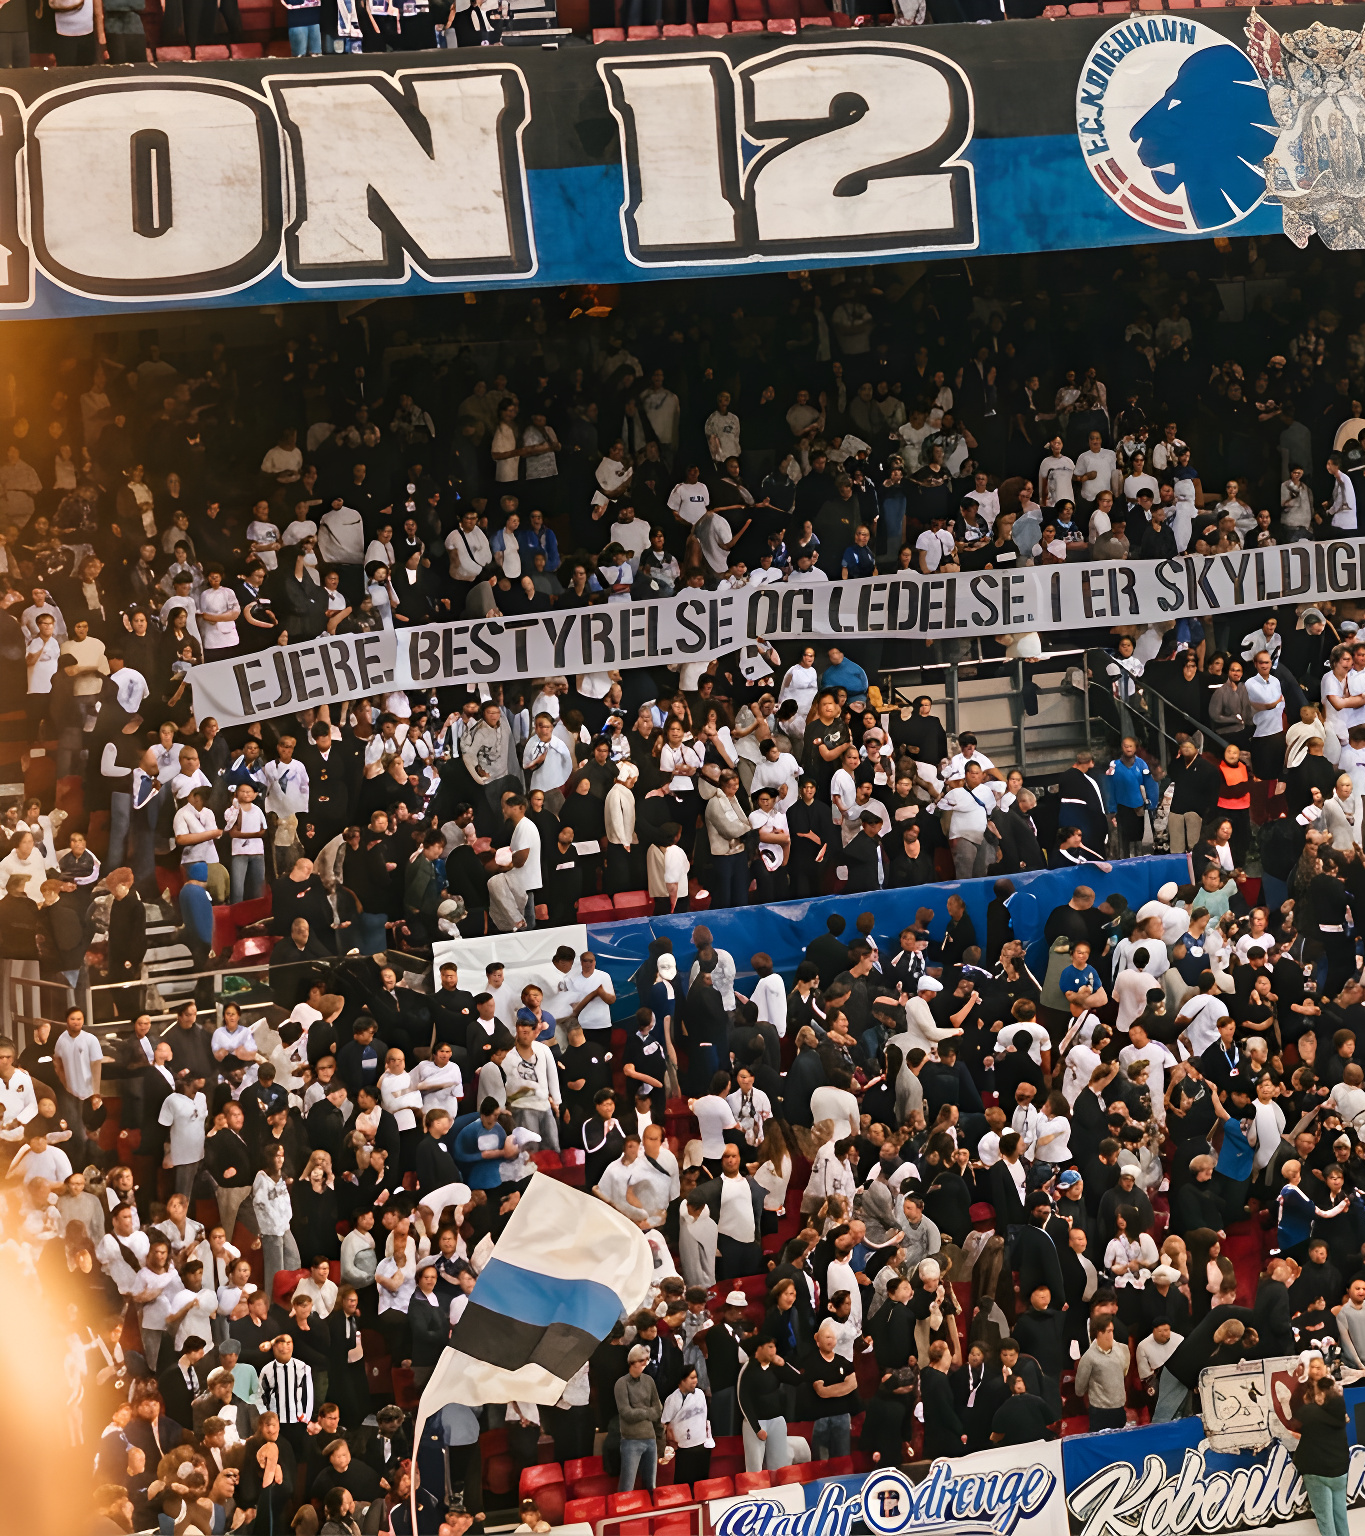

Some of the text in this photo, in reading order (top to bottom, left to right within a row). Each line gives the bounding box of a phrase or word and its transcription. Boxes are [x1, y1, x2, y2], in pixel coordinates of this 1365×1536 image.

[0, 42, 980, 309] ON 12
[409, 597, 734, 681] BESTYRELSE
[747, 588, 813, 639] OG
[1050, 571, 1061, 622] I
[1081, 567, 1140, 619] ER
